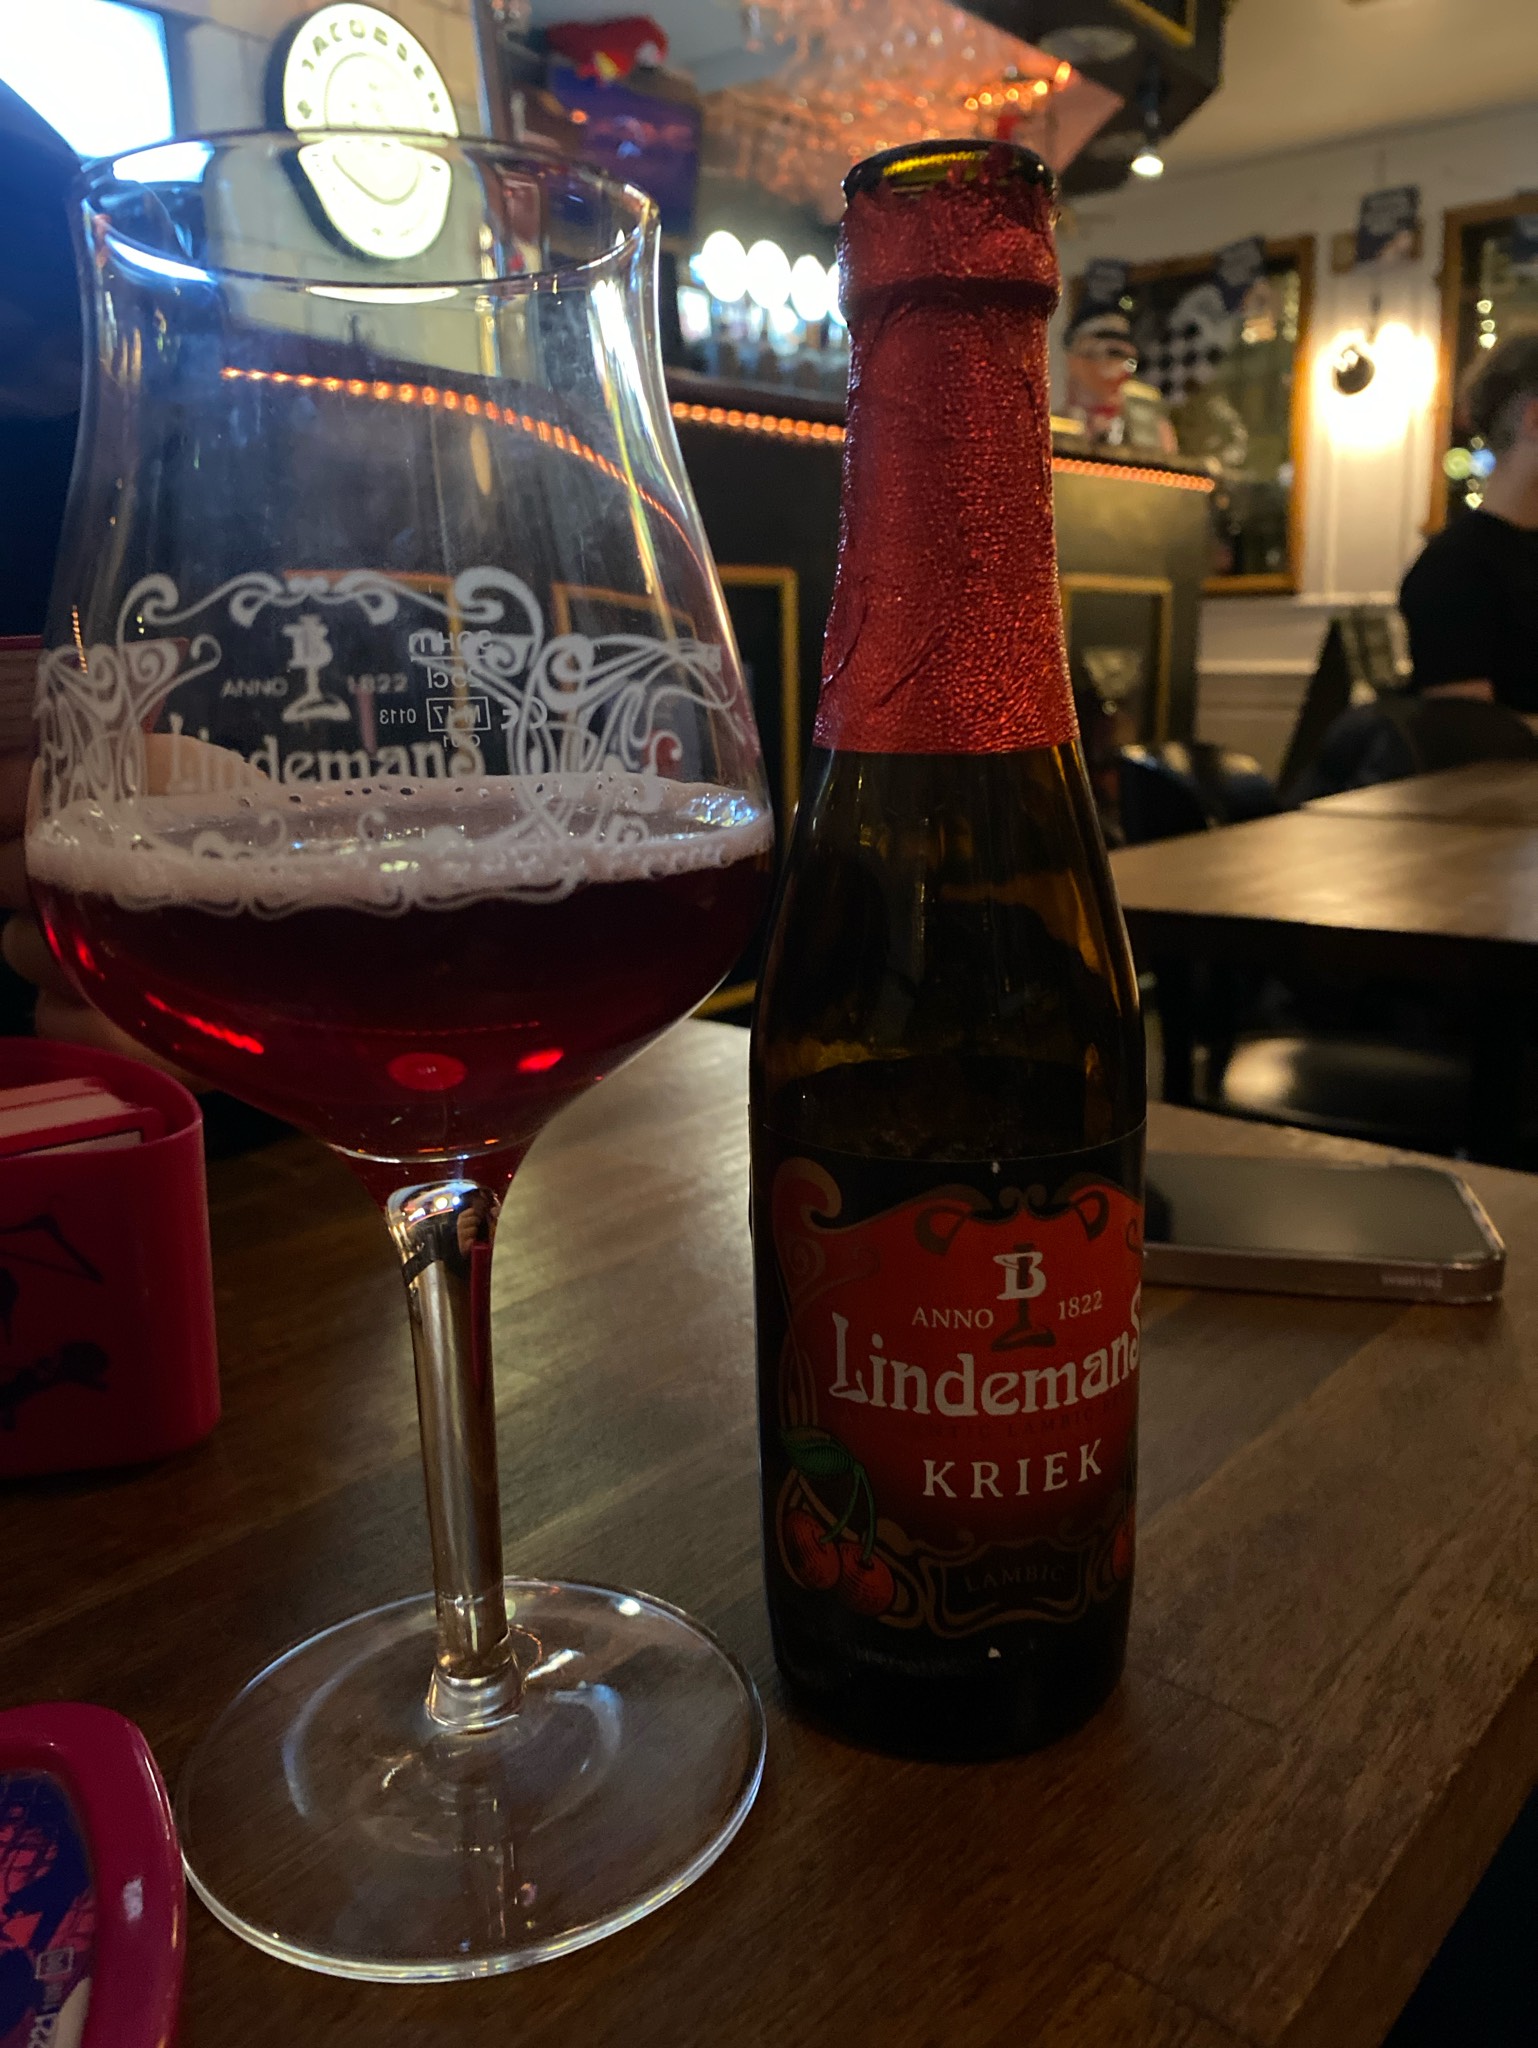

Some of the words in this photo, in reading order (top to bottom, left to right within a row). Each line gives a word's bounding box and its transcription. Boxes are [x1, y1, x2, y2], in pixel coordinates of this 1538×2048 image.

[221, 676, 288, 698] ANNO
[348, 673, 408, 694] 1822
[912, 1307, 994, 1328] ANNO
[1057, 1290, 1102, 1320] 1822
[828, 1281, 1141, 1417] Lindemans
[922, 1438, 1101, 1498] KRIEK
[965, 1564, 1064, 1593] LAMBIC
